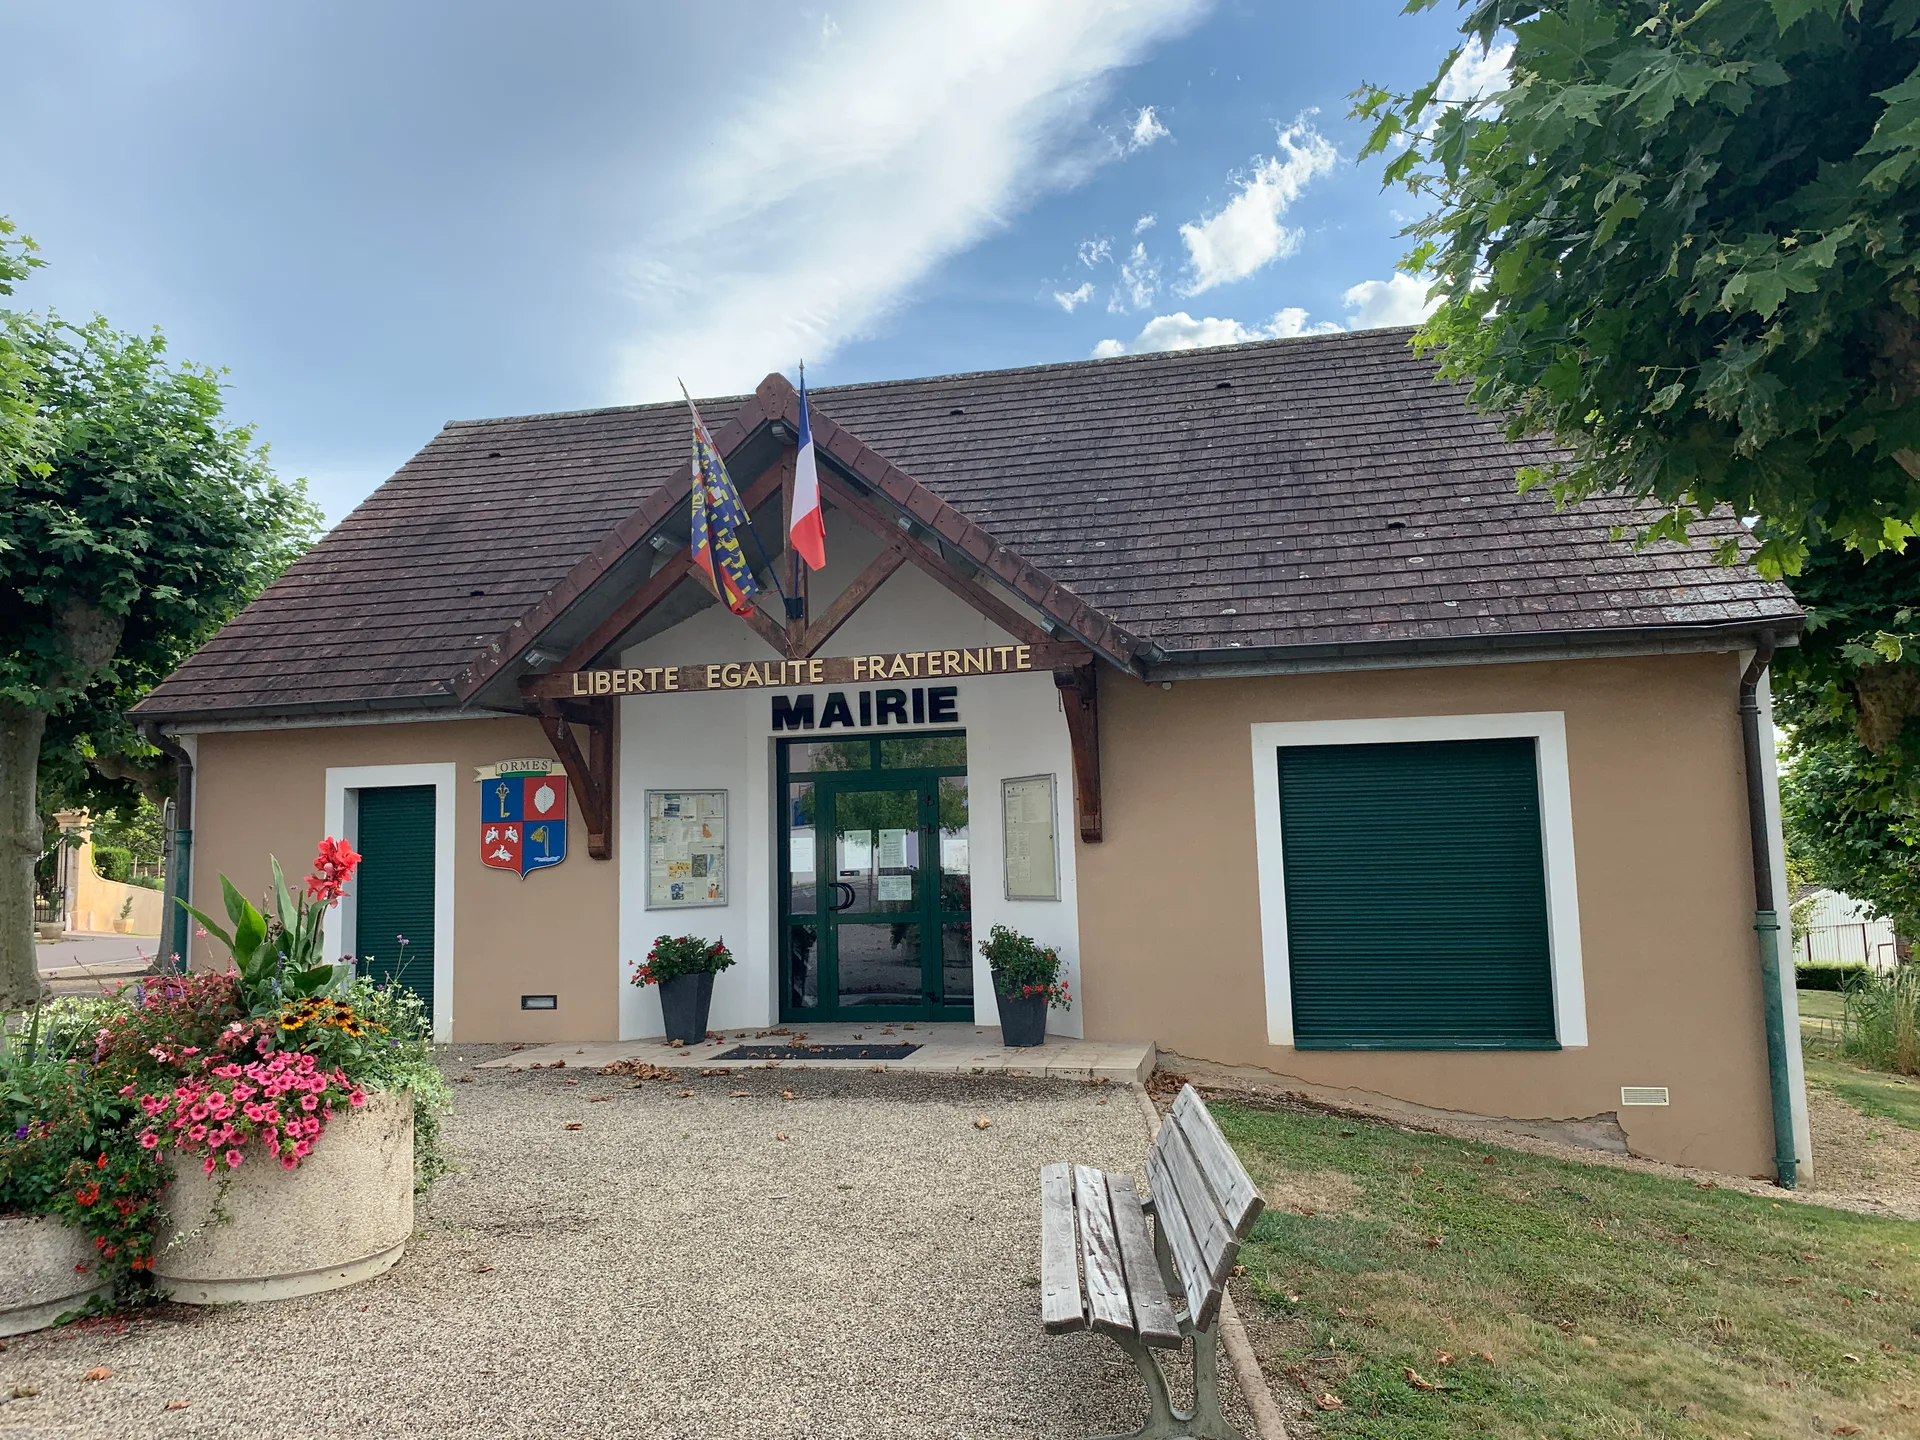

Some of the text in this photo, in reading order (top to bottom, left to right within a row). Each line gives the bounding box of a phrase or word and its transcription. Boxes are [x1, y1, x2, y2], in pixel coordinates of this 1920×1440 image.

[573, 645, 1032, 696] LIBERTE EGALITE FRATERNITE
[771, 686, 959, 731] MAIRIE
[500, 760, 548, 772] ORMES
